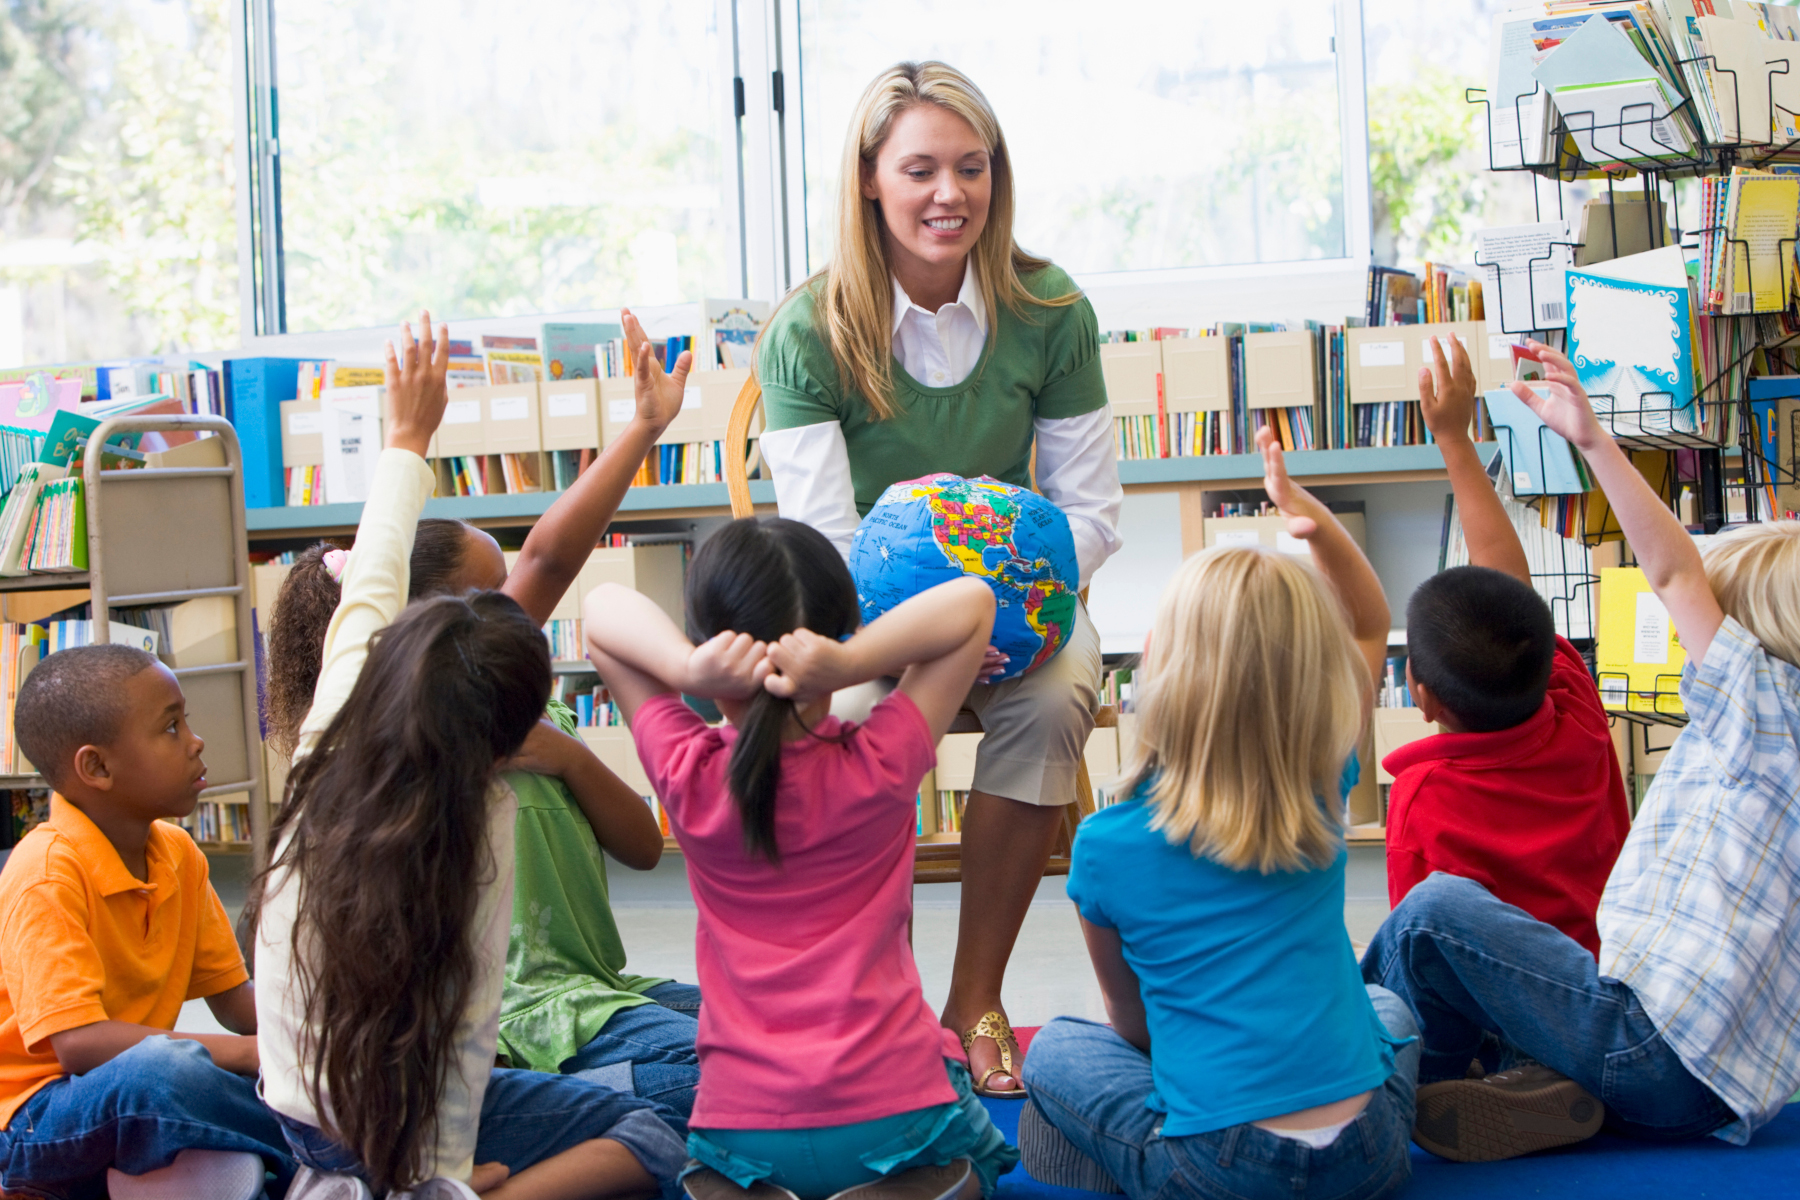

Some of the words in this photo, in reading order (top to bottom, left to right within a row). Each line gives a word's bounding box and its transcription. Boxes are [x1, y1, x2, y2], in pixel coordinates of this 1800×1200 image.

[882, 512, 900, 520] NORTH
[869, 516, 889, 526] PACIFIC
[888, 521, 908, 531] OCEAN
